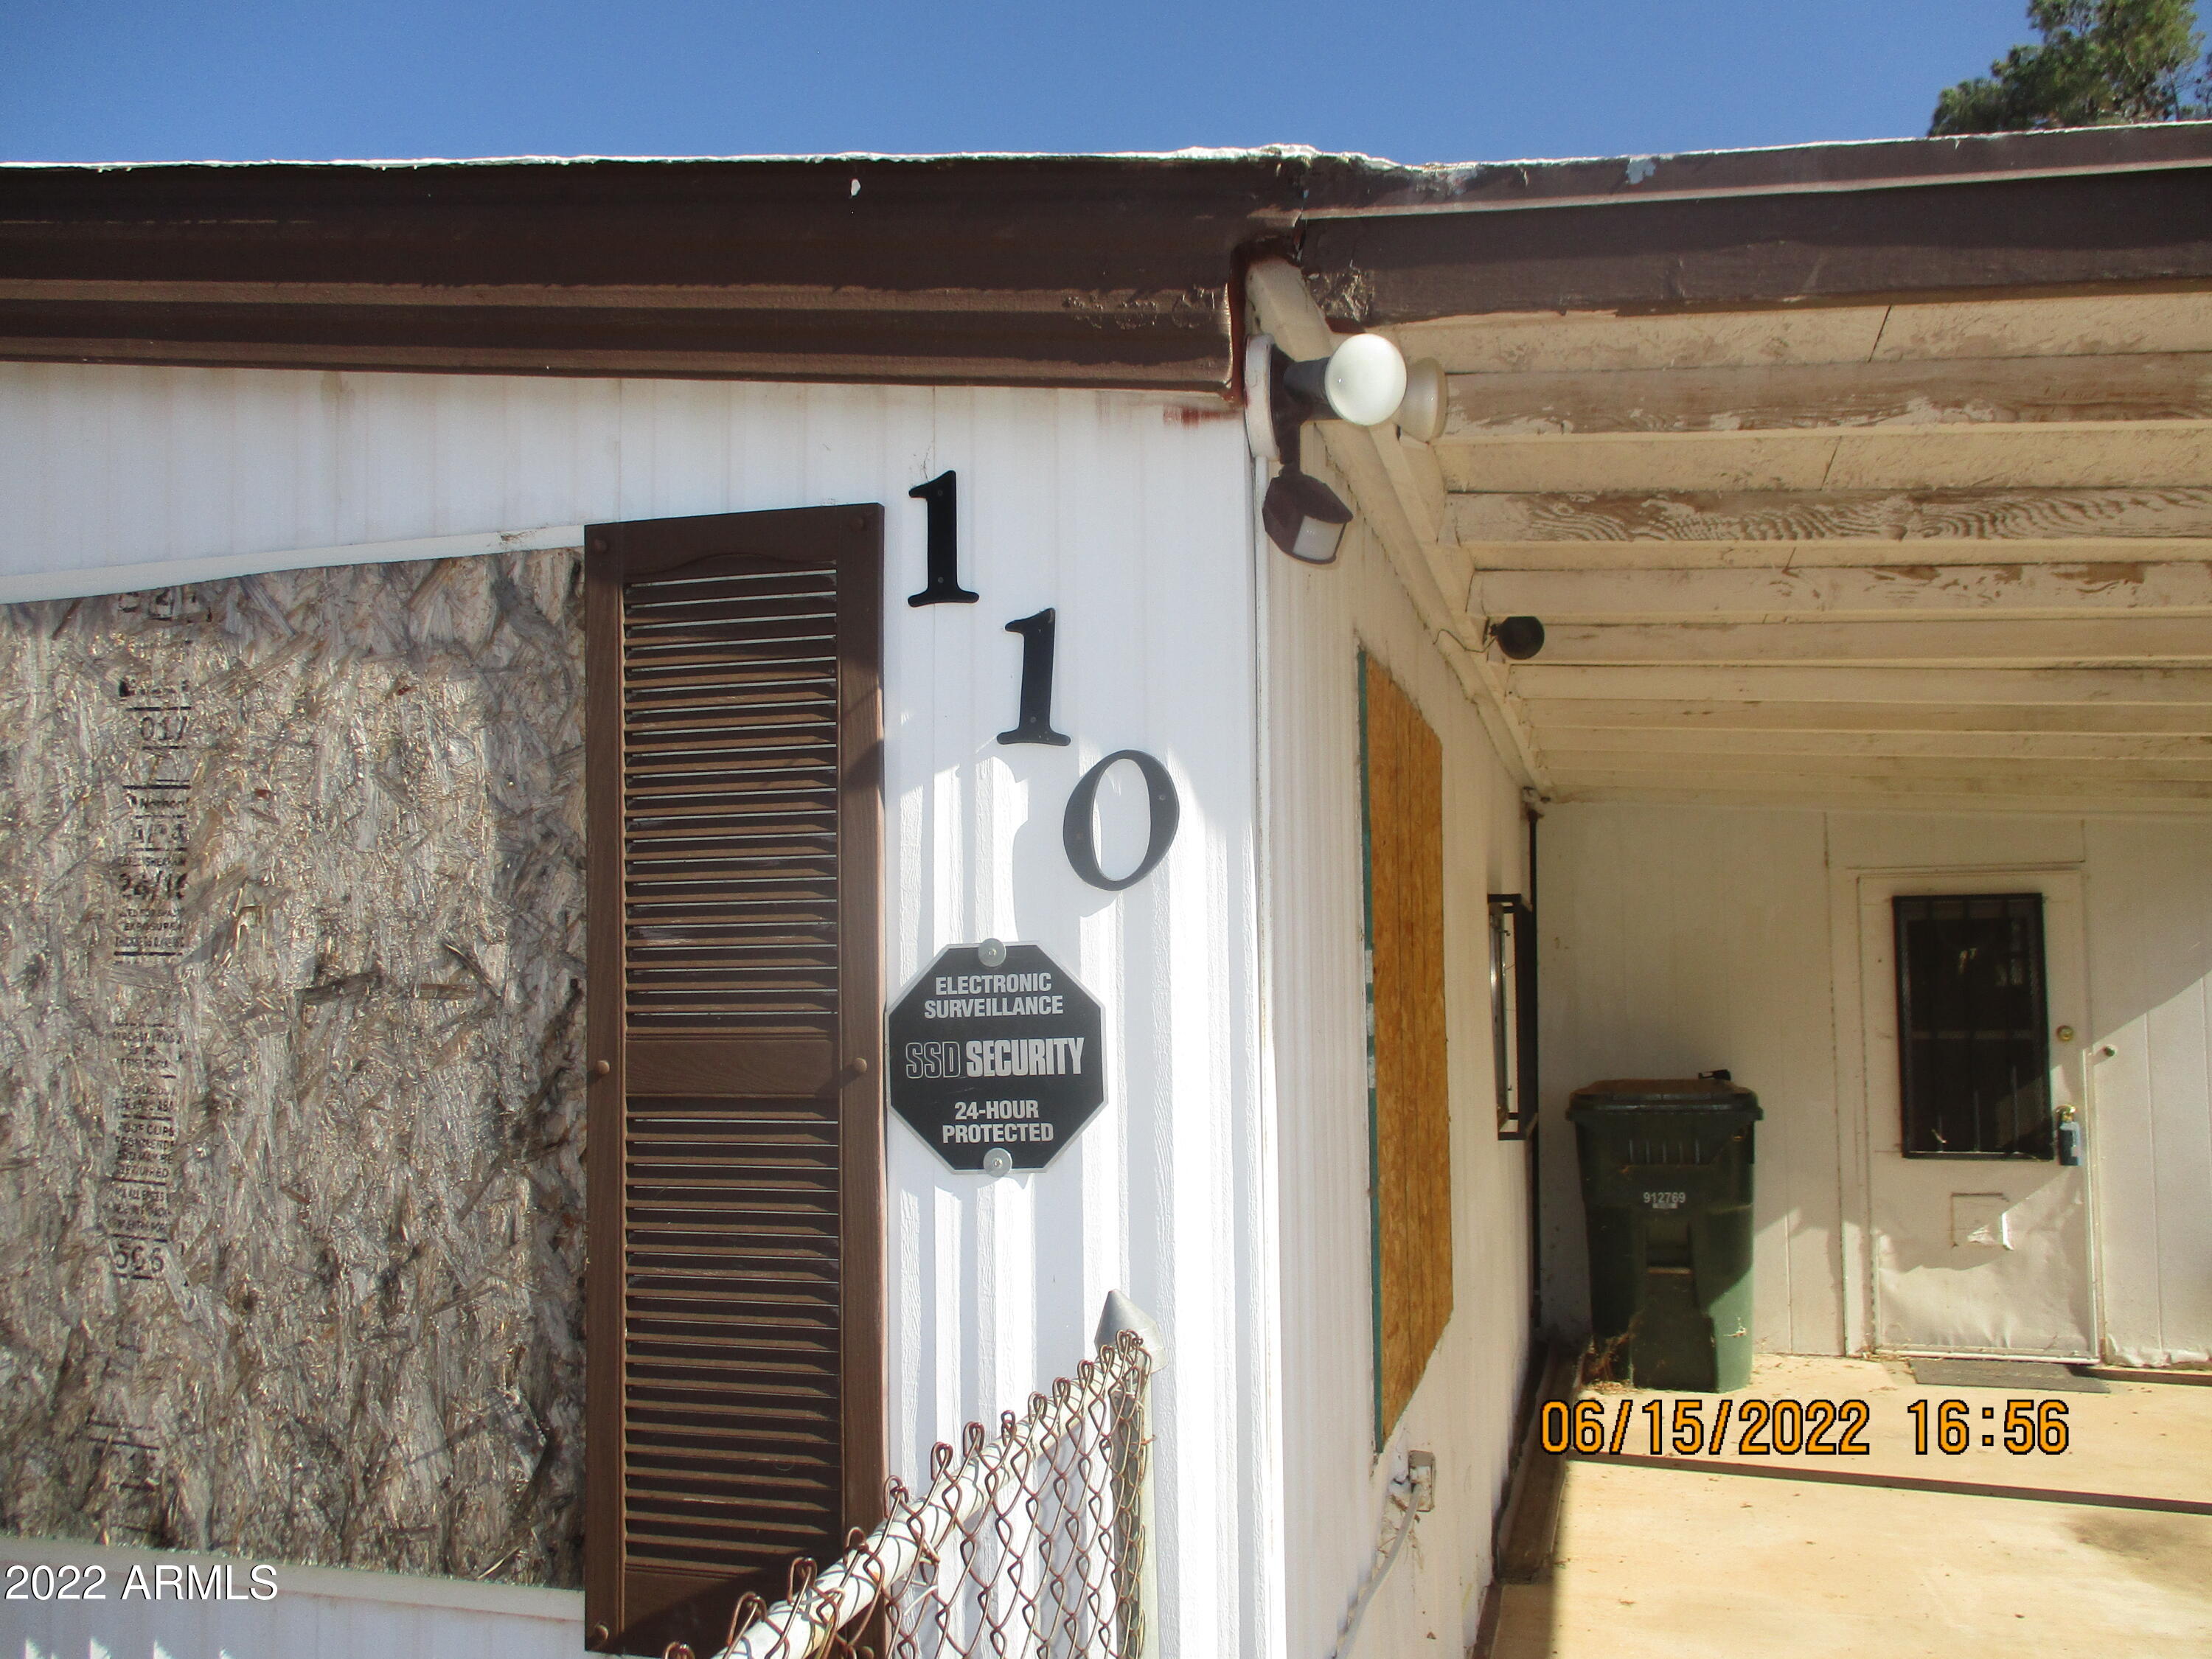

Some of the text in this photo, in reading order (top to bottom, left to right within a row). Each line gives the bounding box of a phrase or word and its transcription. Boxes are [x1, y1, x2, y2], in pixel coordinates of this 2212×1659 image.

[908, 470, 1180, 891] 110
[935, 973, 1052, 995] ELECTRONIC
[924, 995, 1064, 1019] SURVEILLANCE
[905, 1037, 1085, 1079] SSD SECURITY
[954, 1100, 1040, 1120] 24-HOUR
[942, 1123, 1054, 1144] PROTECTED
[1643, 1192, 1686, 1203] 912769
